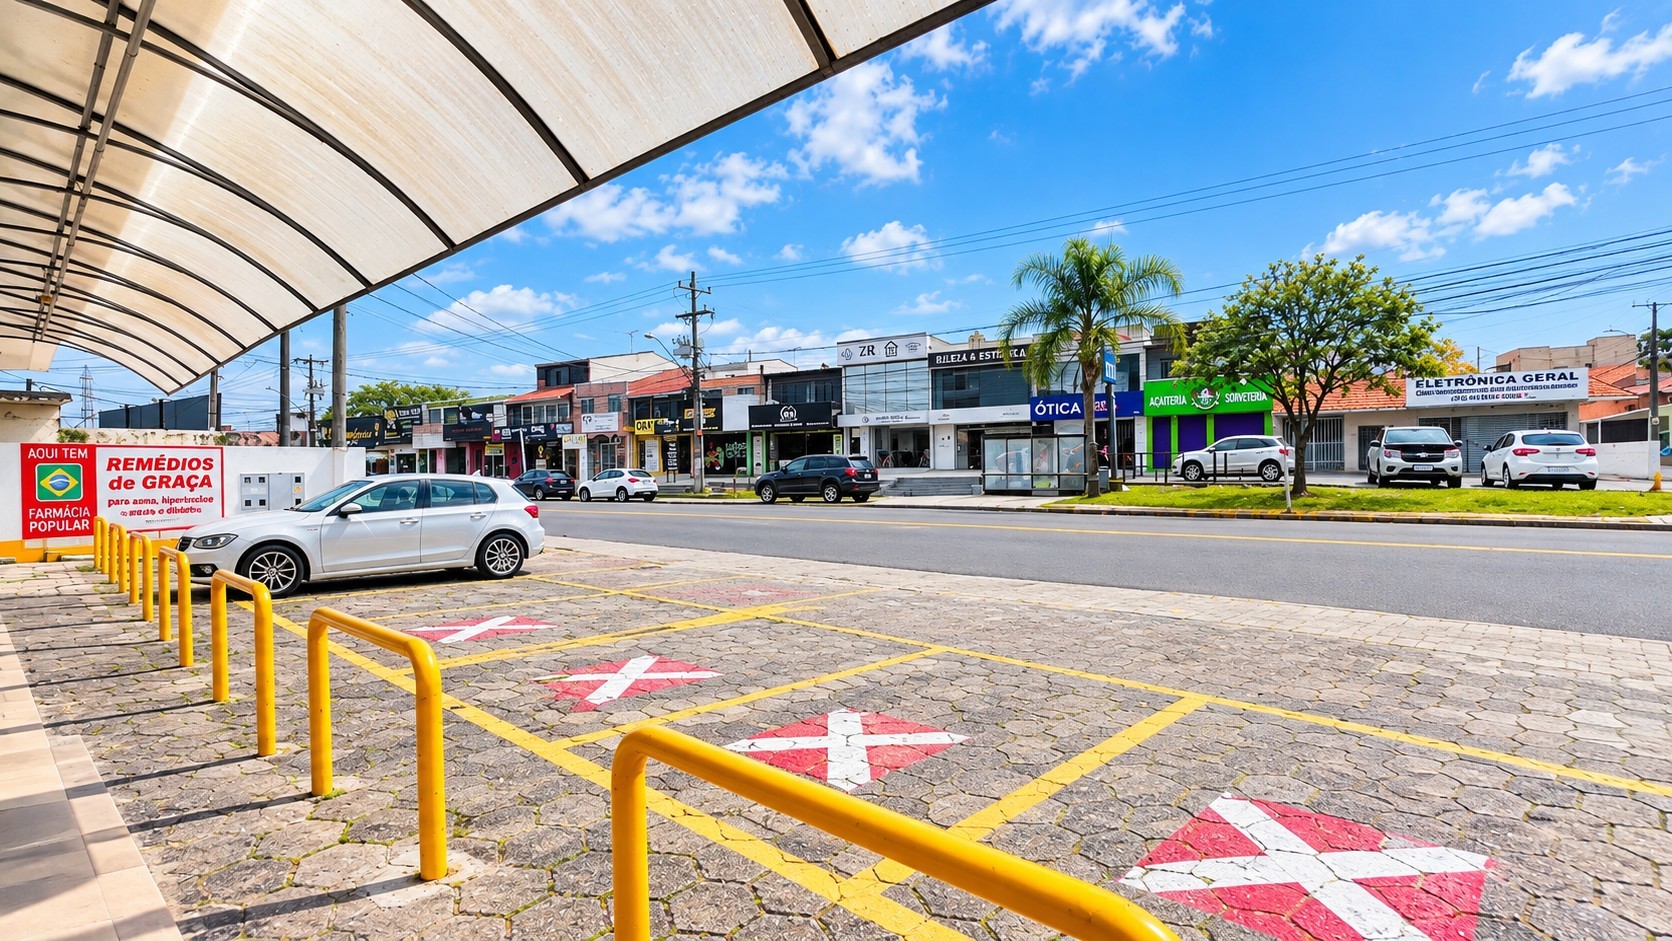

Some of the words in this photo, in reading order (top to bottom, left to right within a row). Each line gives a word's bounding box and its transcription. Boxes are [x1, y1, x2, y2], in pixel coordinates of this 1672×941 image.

[858, 344, 876, 357] ZR
[1415, 374, 1516, 389] ELETRÔNICA
[1522, 371, 1579, 383] GERAL
[1034, 400, 1081, 416] ÓTICA
[1149, 394, 1187, 408] AÇAITERIA
[28, 448, 58, 460] AQUI
[62, 448, 88, 459] TEM
[106, 454, 214, 472] REMÉDIOS
[108, 476, 136, 491] de
[142, 474, 213, 493] GRAÇA
[28, 505, 91, 520] FARMÁCIA
[29, 519, 90, 533] POPULAR
